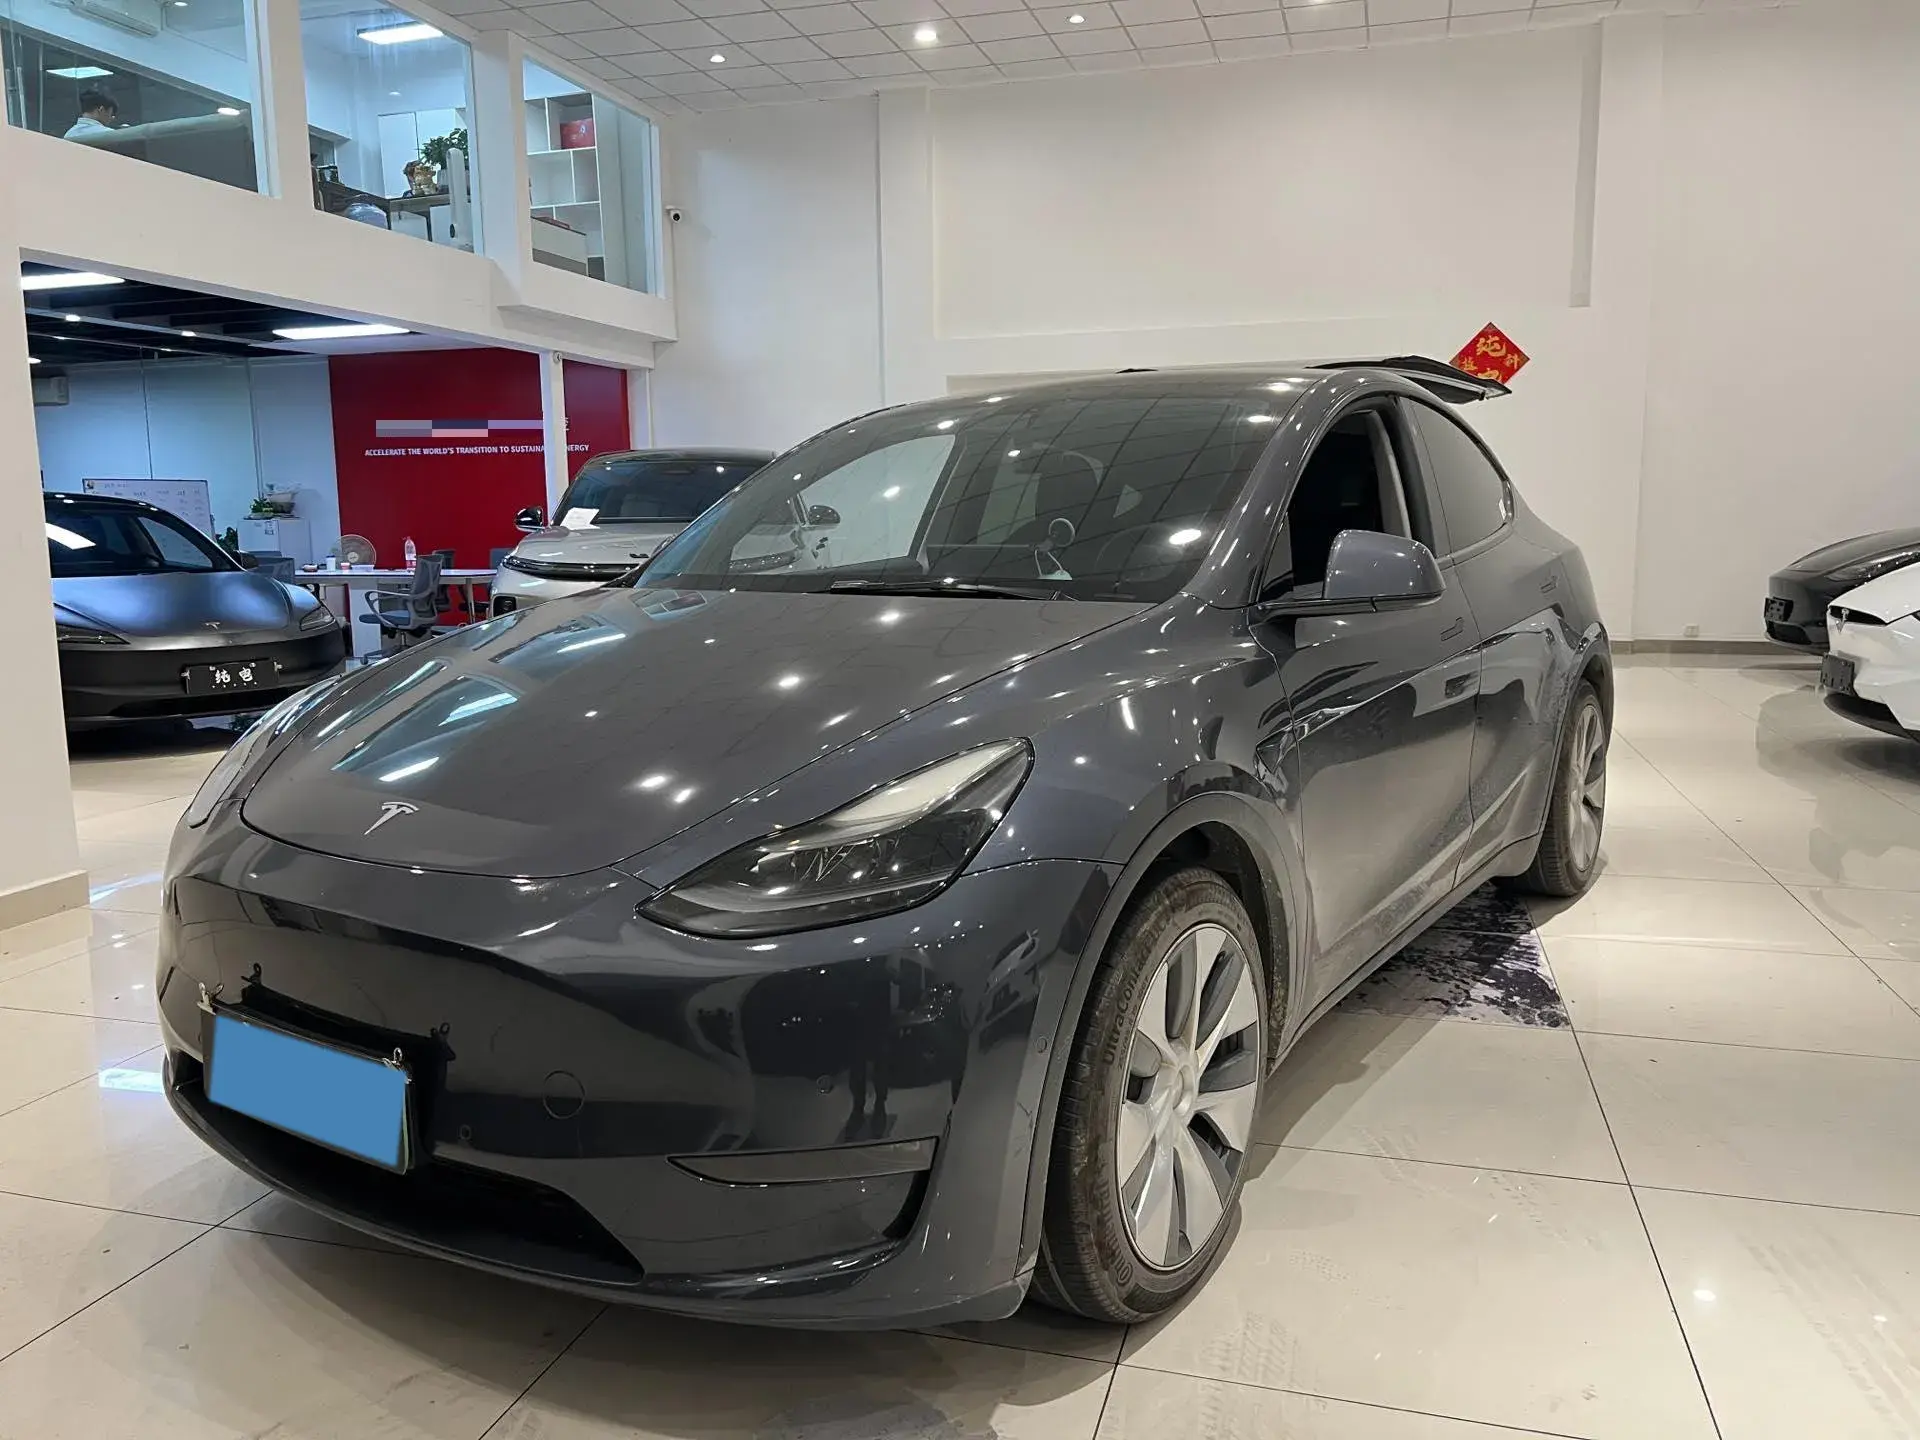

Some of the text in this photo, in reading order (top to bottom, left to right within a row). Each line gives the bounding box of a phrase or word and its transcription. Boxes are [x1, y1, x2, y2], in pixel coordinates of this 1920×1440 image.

[365, 448, 406, 456] ACCELERATE
[423, 447, 454, 455] WORLD'S
[500, 446, 510, 454] TO
